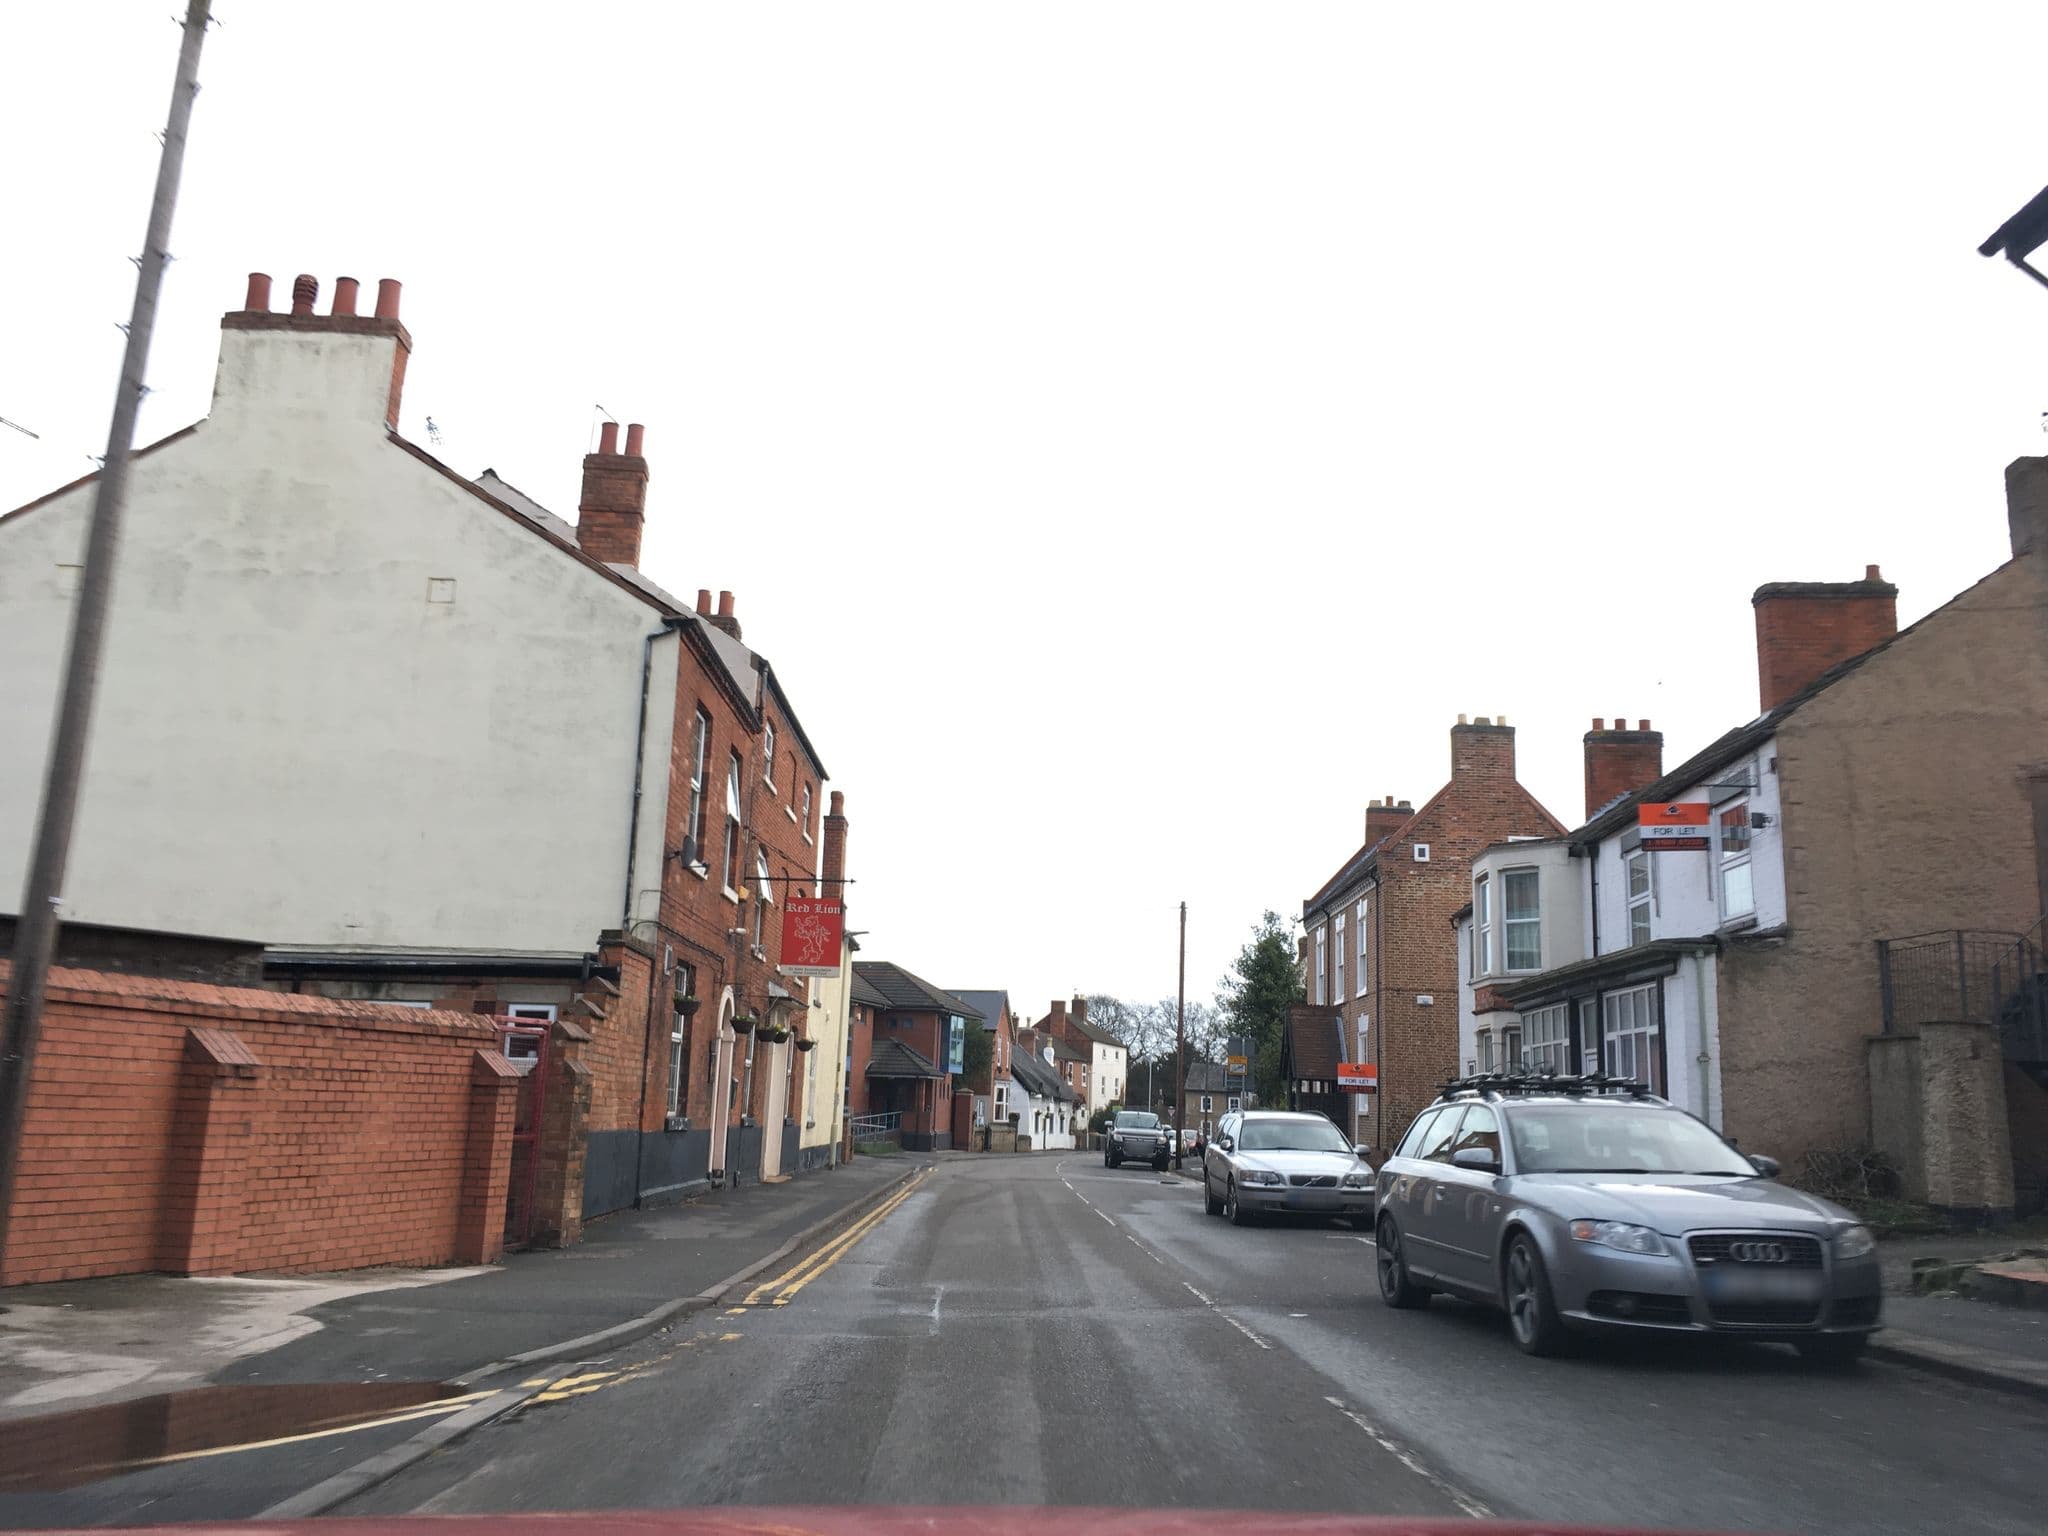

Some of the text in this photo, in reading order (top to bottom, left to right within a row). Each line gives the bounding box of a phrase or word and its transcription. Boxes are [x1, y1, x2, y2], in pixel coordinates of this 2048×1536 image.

[1653, 827, 1696, 835] FOR LET
[786, 903, 841, 914] Red Lion
